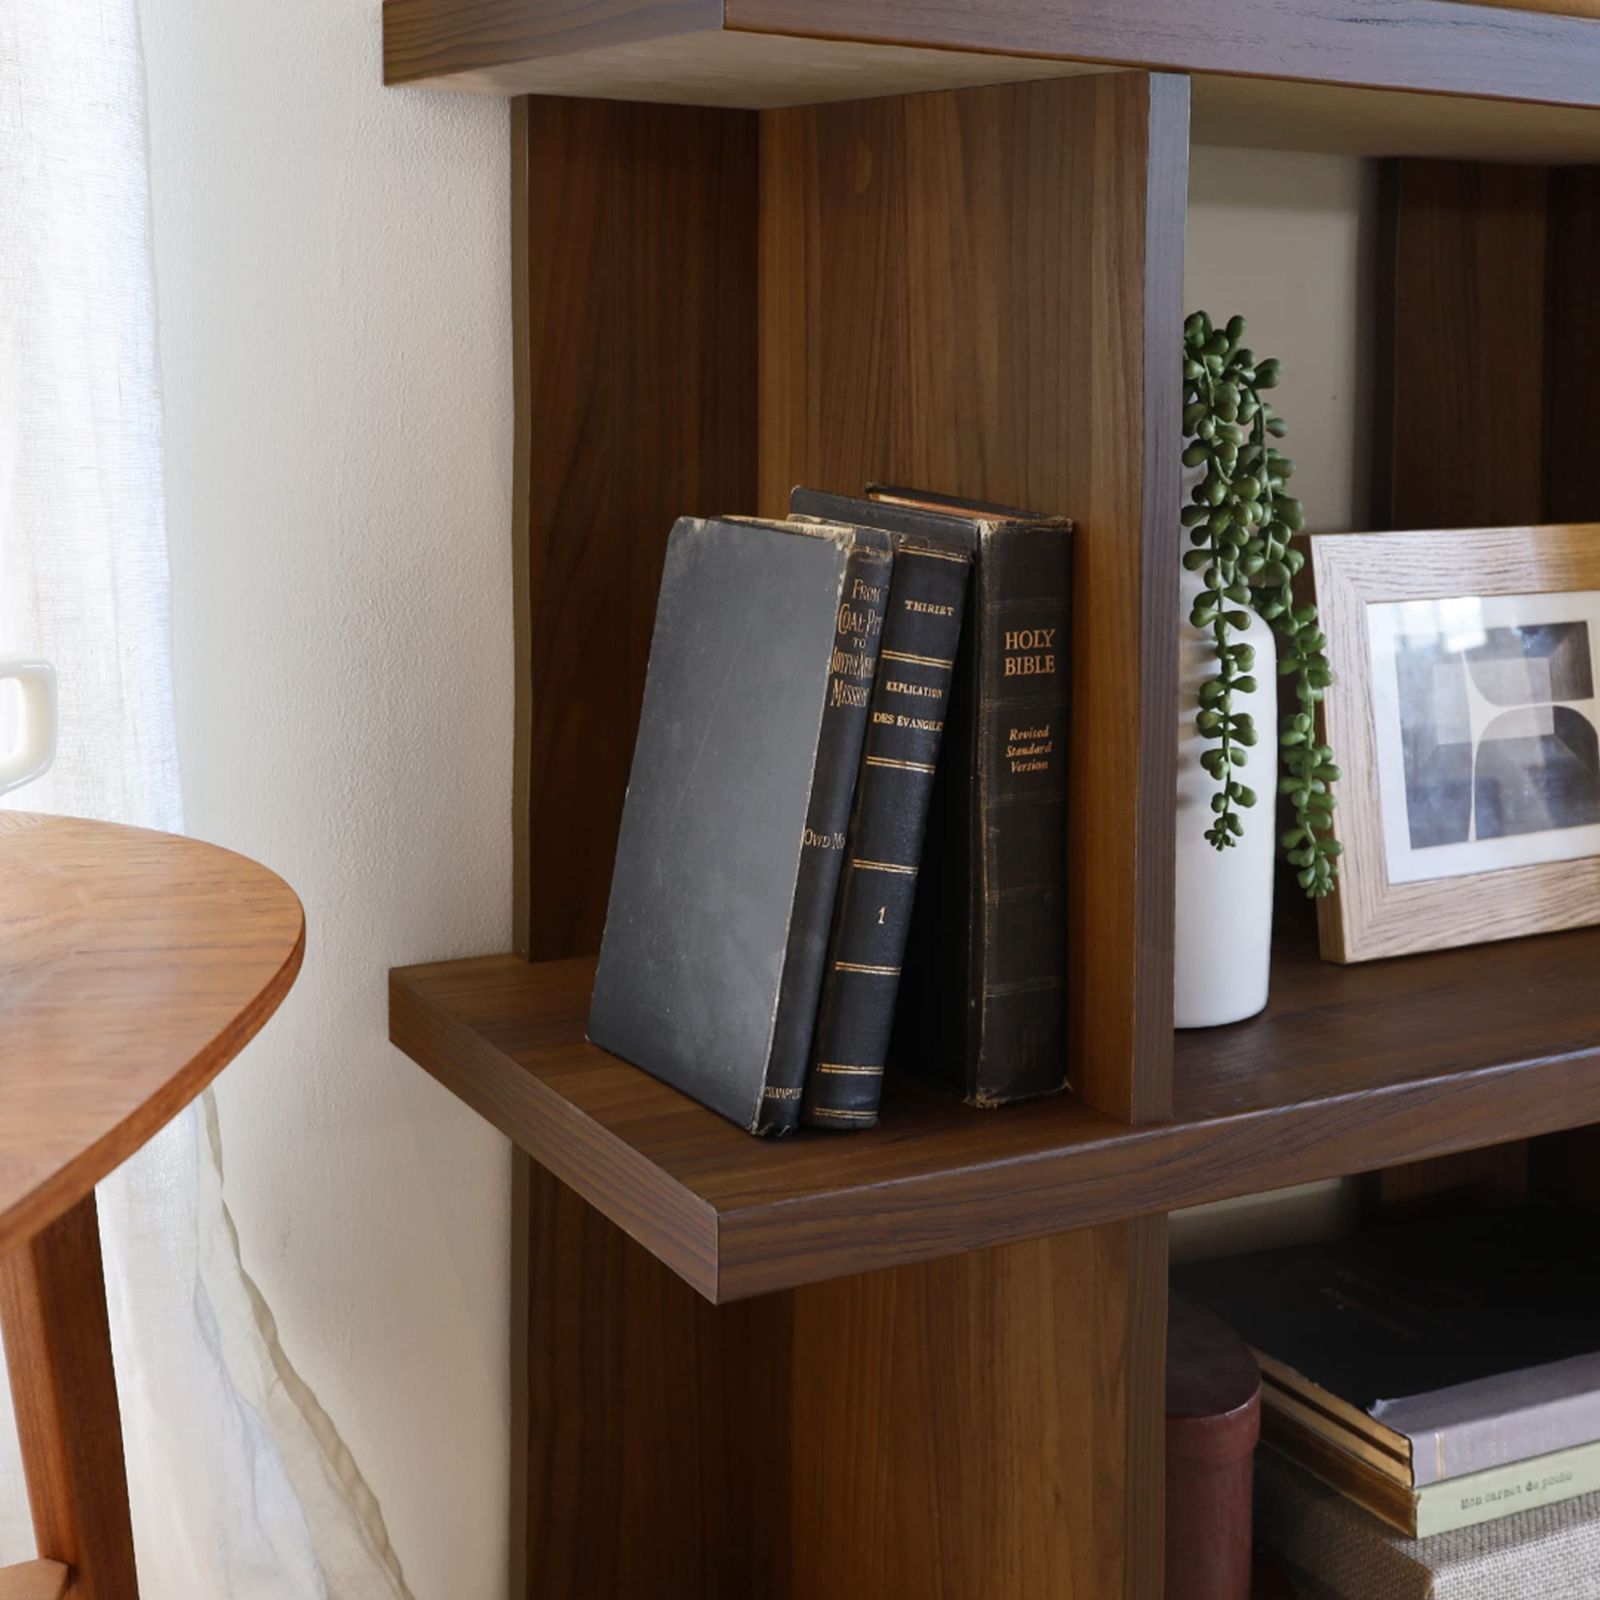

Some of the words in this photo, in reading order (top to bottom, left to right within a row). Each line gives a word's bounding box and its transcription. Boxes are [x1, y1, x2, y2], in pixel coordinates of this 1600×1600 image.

[905, 600, 955, 617] THIRIET
[1005, 629, 1056, 651] HOLY
[1004, 655, 1056, 677] BIBLE
[886, 681, 943, 699] EXPLICATION
[873, 712, 895, 725] DES
[1009, 725, 1049, 742] Revised
[1006, 741, 1052, 758] Standard
[1010, 758, 1049, 774] Version
[877, 906, 887, 925] 1
[1460, 1496, 1482, 1510] Mon
